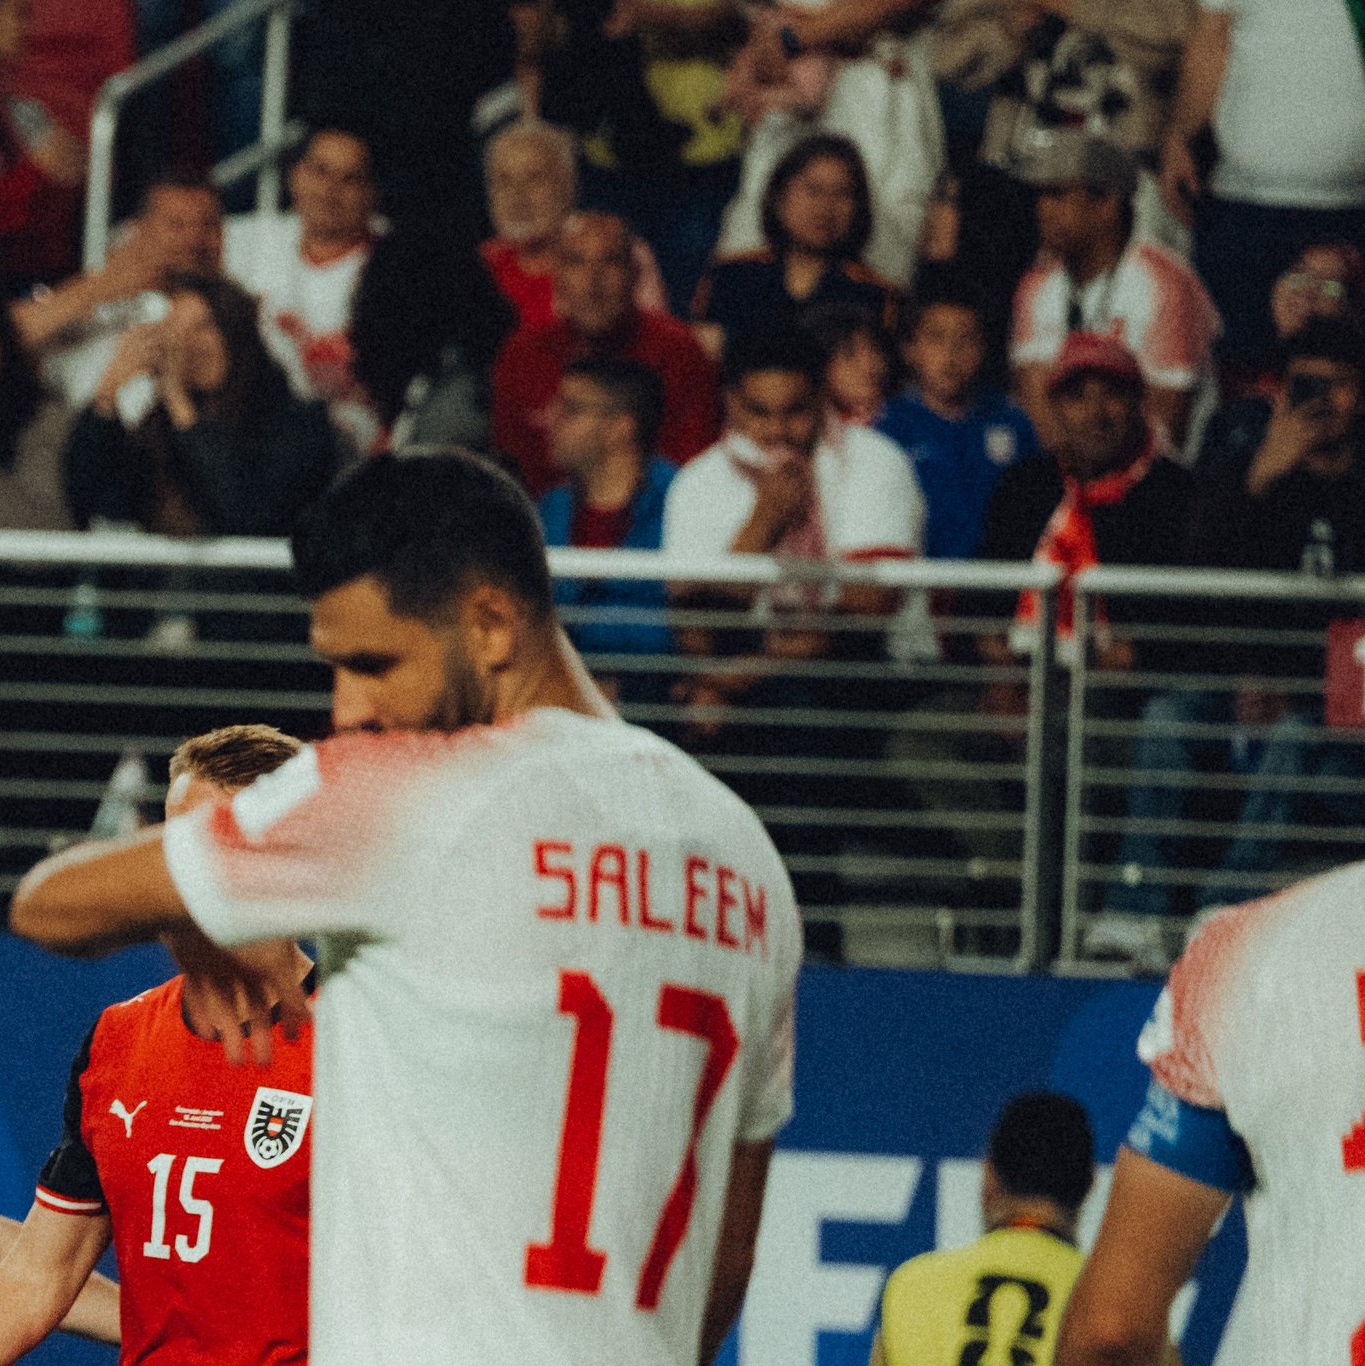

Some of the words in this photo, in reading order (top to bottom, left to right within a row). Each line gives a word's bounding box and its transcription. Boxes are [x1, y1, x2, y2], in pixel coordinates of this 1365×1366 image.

[533, 839, 769, 956] SALEEM
[524, 968, 740, 1313] 17
[143, 1153, 224, 1263] 15
